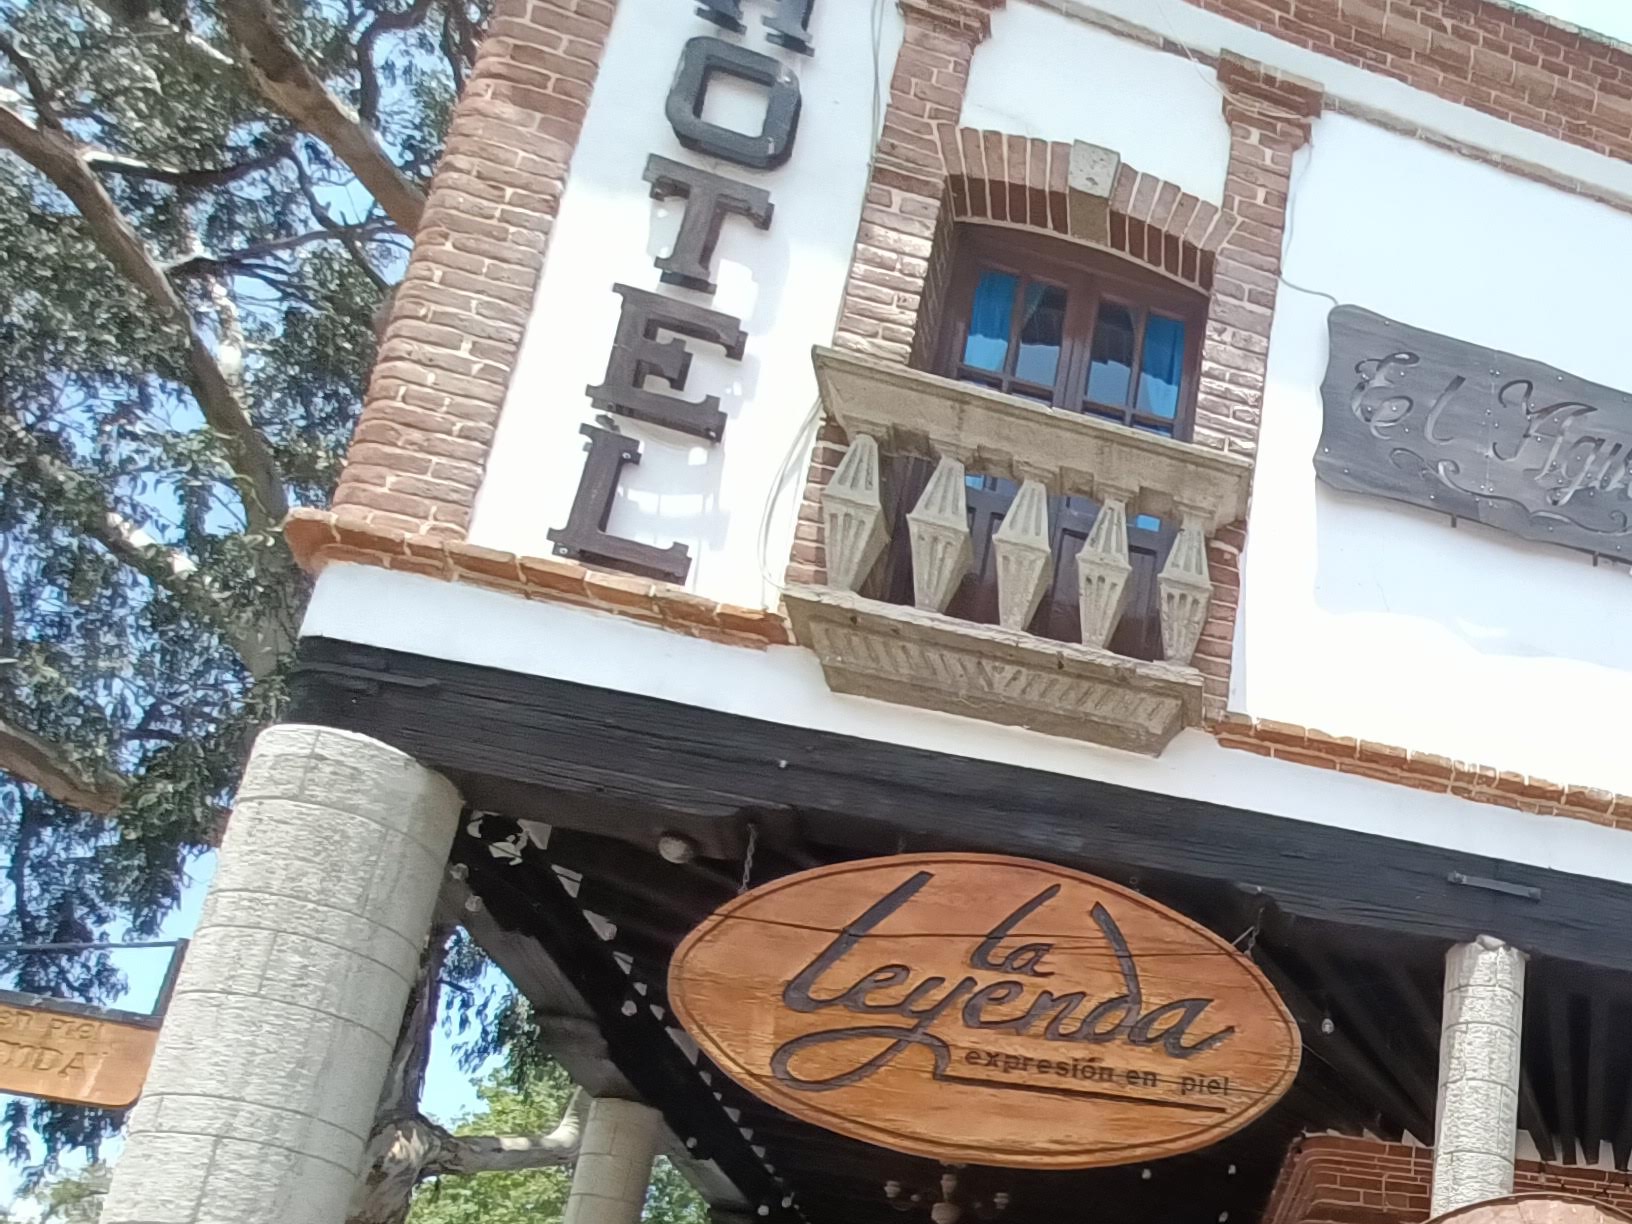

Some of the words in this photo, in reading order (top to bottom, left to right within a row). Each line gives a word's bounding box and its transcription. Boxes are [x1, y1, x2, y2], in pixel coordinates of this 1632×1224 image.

[1351, 351, 1467, 446] El
[1126, 1069, 1158, 1088] en
[1180, 1075, 1230, 1096] piel
